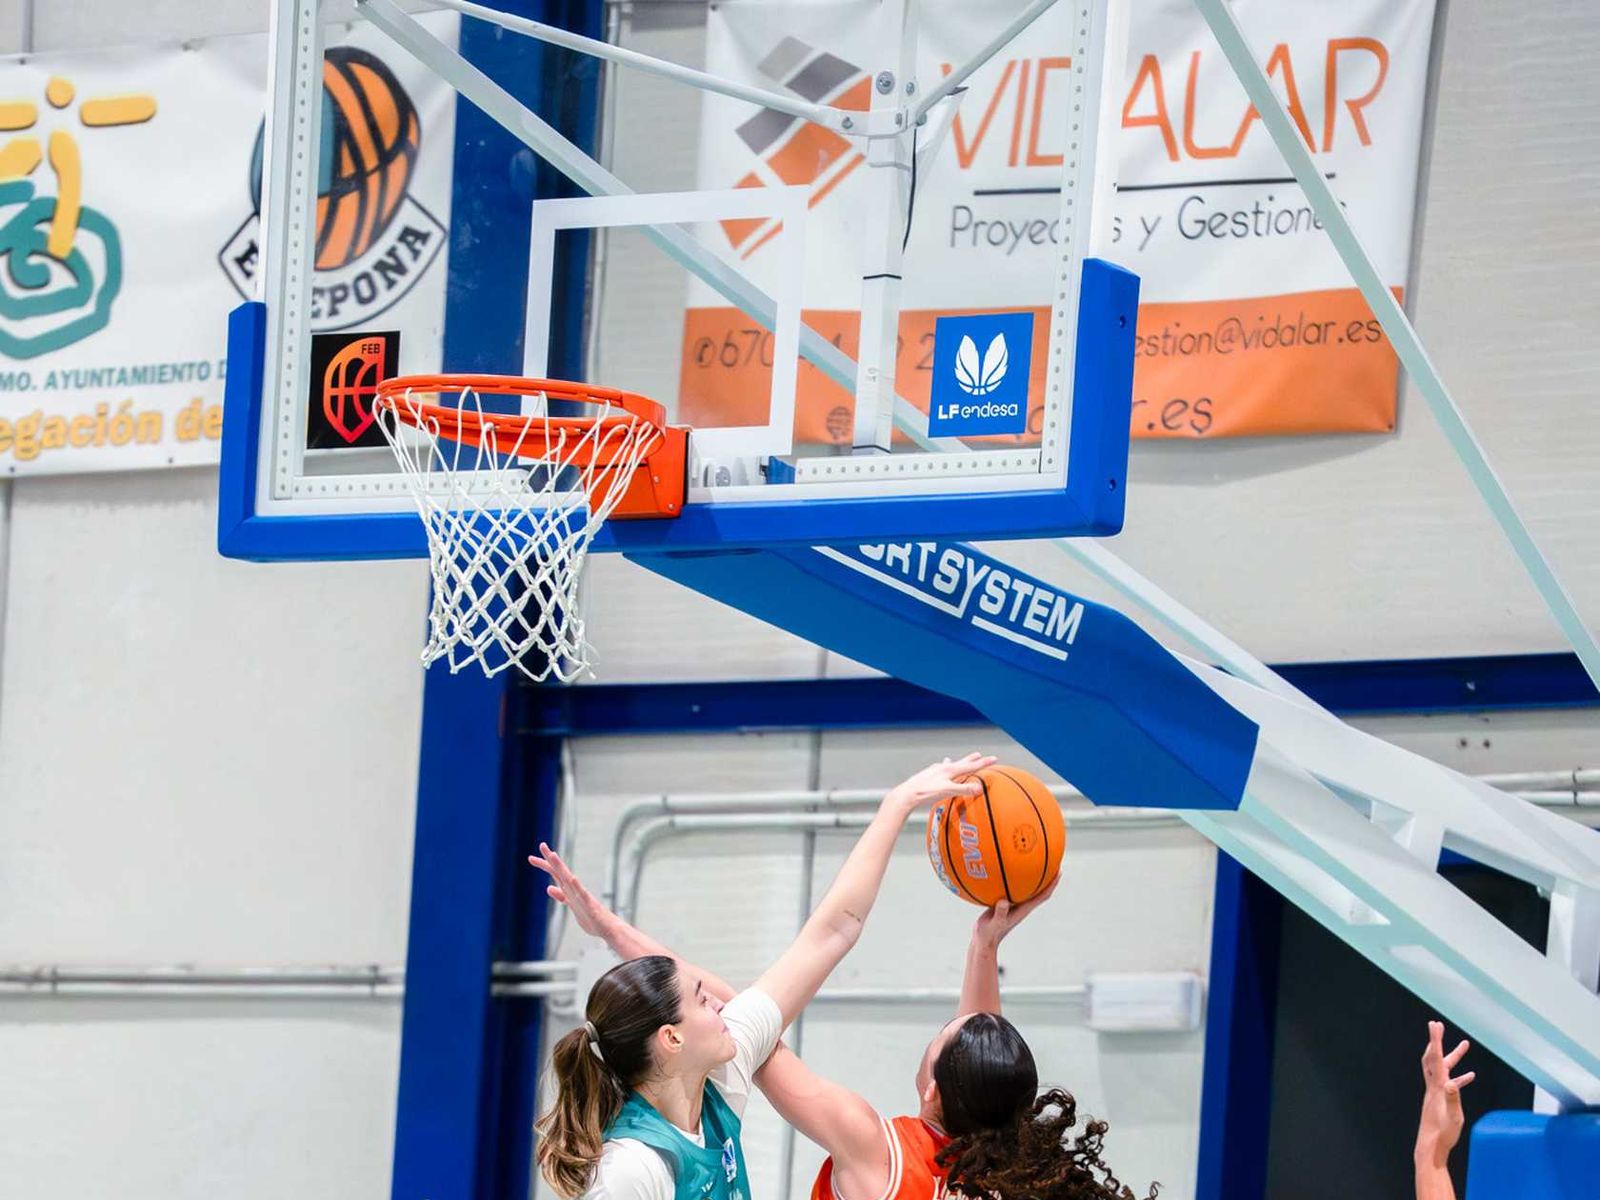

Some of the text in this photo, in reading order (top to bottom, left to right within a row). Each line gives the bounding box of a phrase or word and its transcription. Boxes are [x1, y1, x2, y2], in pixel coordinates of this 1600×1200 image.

[1140, 214, 1162, 251] y
[361, 344, 381, 354] FEB
[44, 359, 210, 390] AYUNTAMIENTO
[938, 400, 1018, 420] LF endesa
